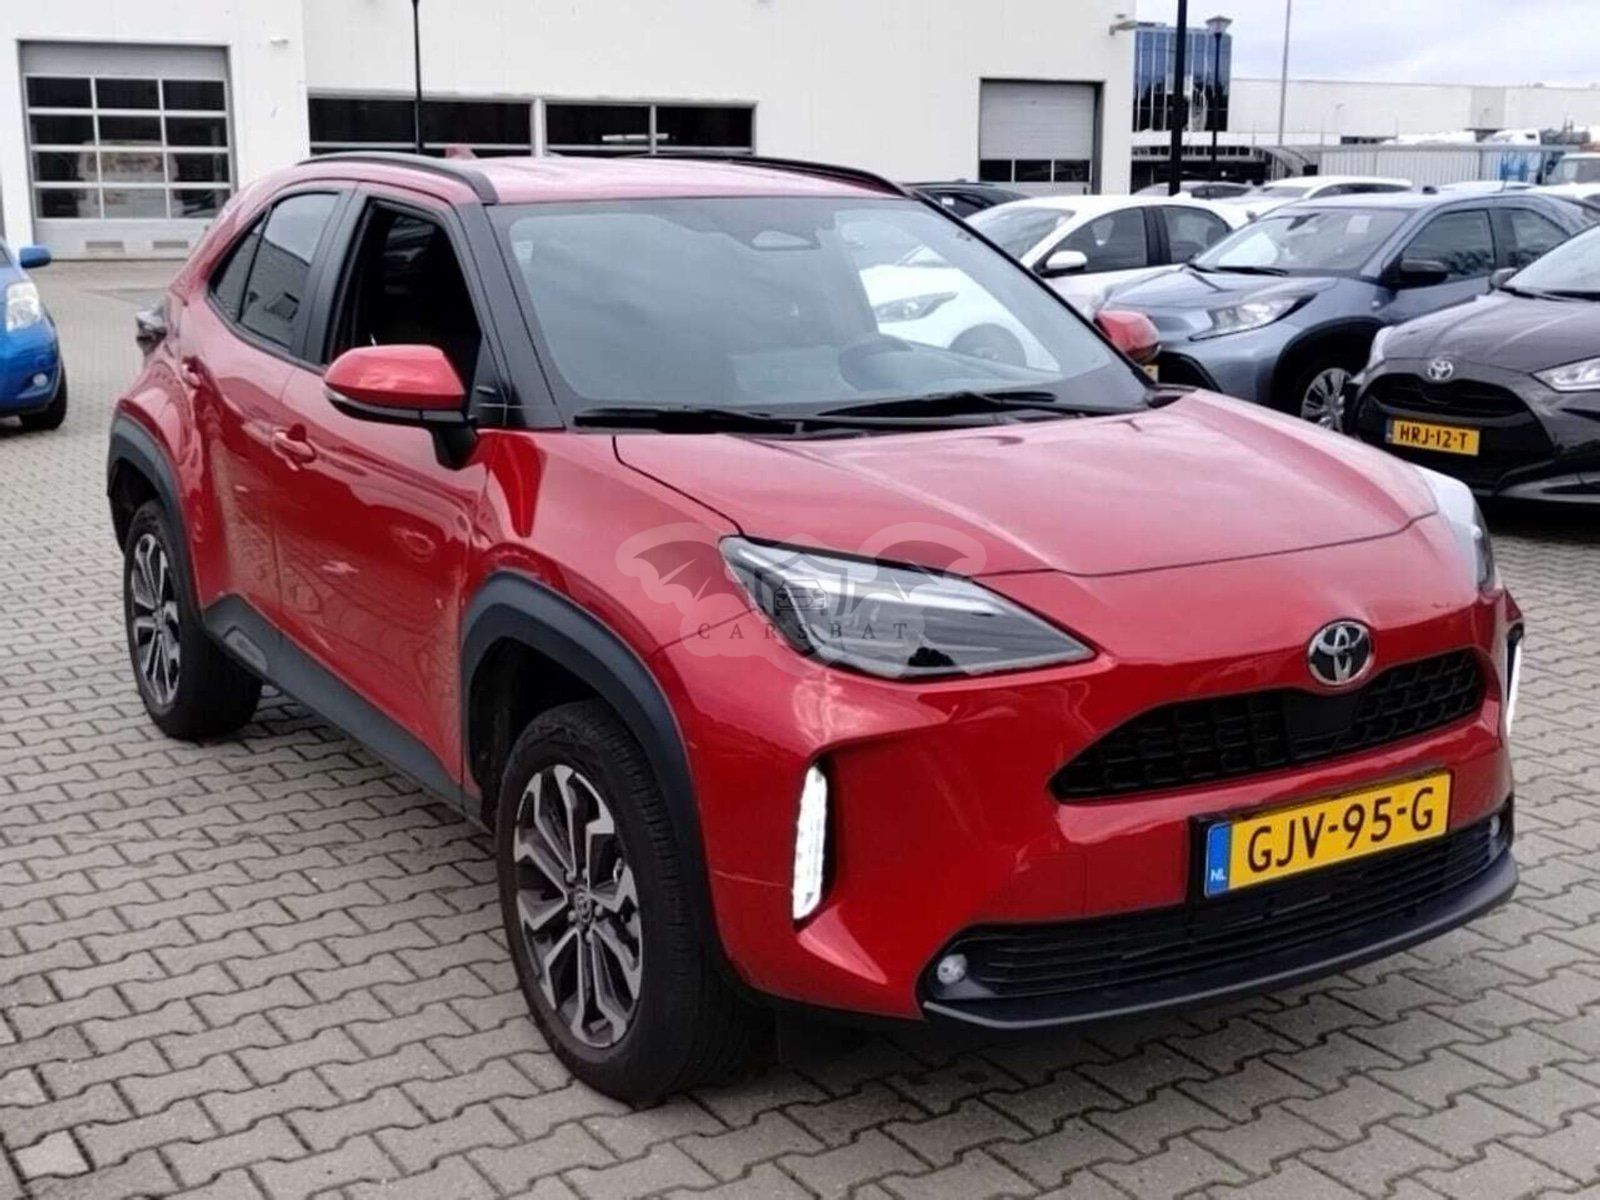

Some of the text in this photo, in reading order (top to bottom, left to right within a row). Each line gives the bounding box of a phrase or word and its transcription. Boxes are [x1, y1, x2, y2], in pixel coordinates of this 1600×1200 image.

[1400, 424, 1468, 450] HRJ-12-T
[1247, 787, 1434, 873] GJV-95-G
[1211, 868, 1227, 882] NL
